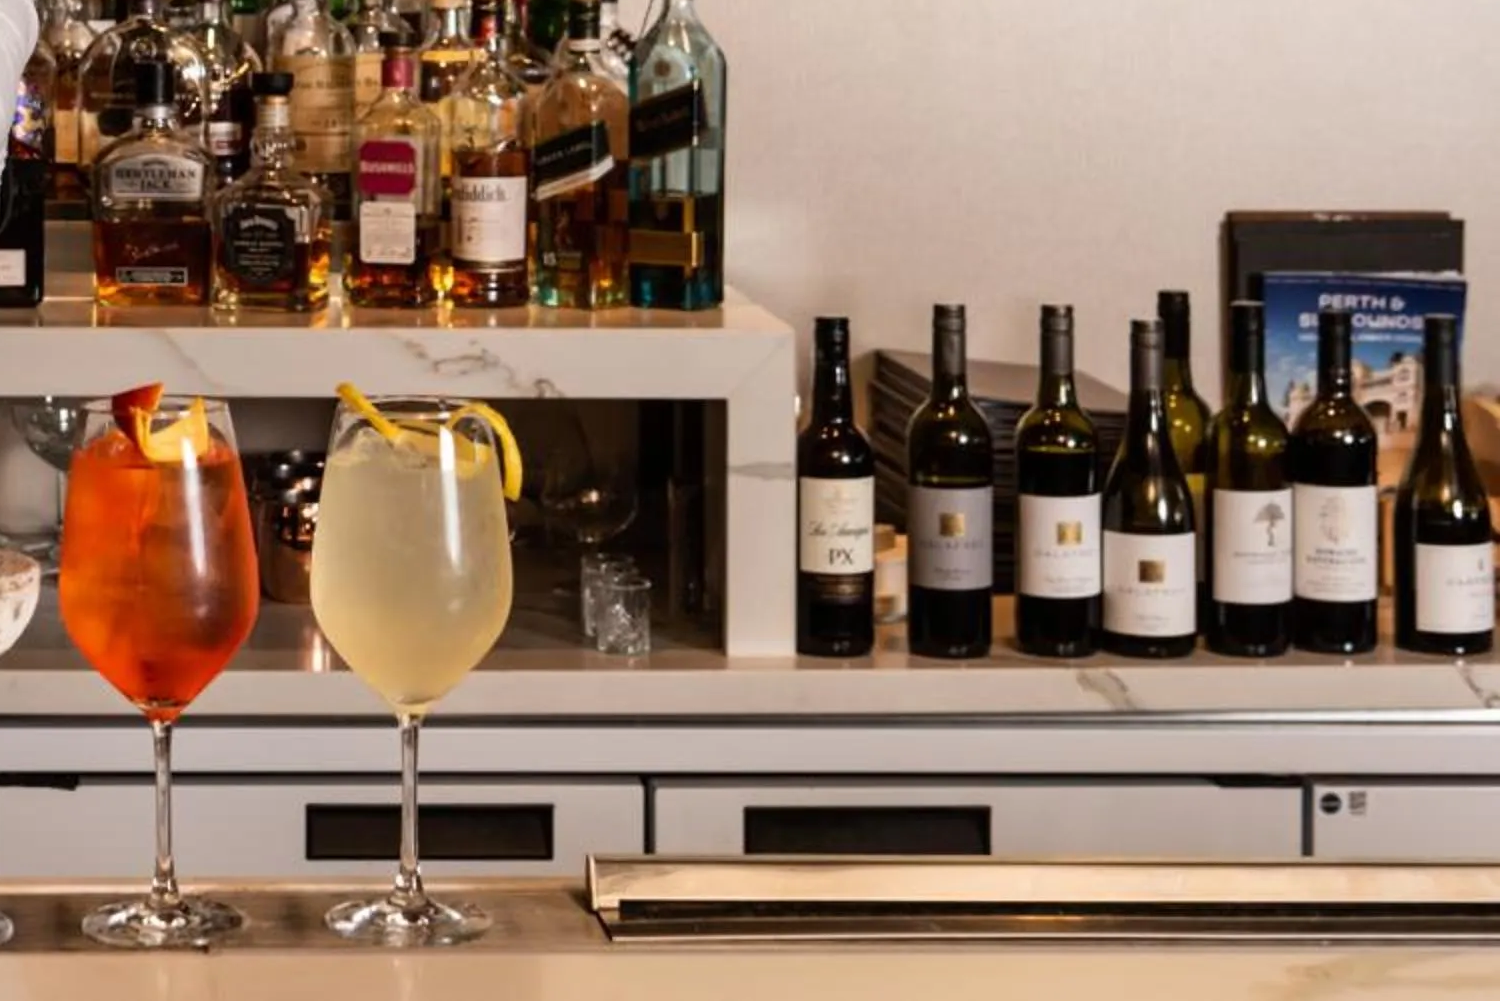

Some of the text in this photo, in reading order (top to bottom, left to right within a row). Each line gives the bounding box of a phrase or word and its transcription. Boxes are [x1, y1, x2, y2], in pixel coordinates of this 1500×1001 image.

[114, 167, 197, 180] GENTLEMAN
[360, 160, 414, 174] BUSHMILLS
[139, 179, 170, 191] JACK
[452, 183, 506, 202] fiddich
[1318, 293, 1406, 311] PERTH &
[1298, 313, 1424, 330] SUOUNDS
[828, 547, 854, 567] PX
